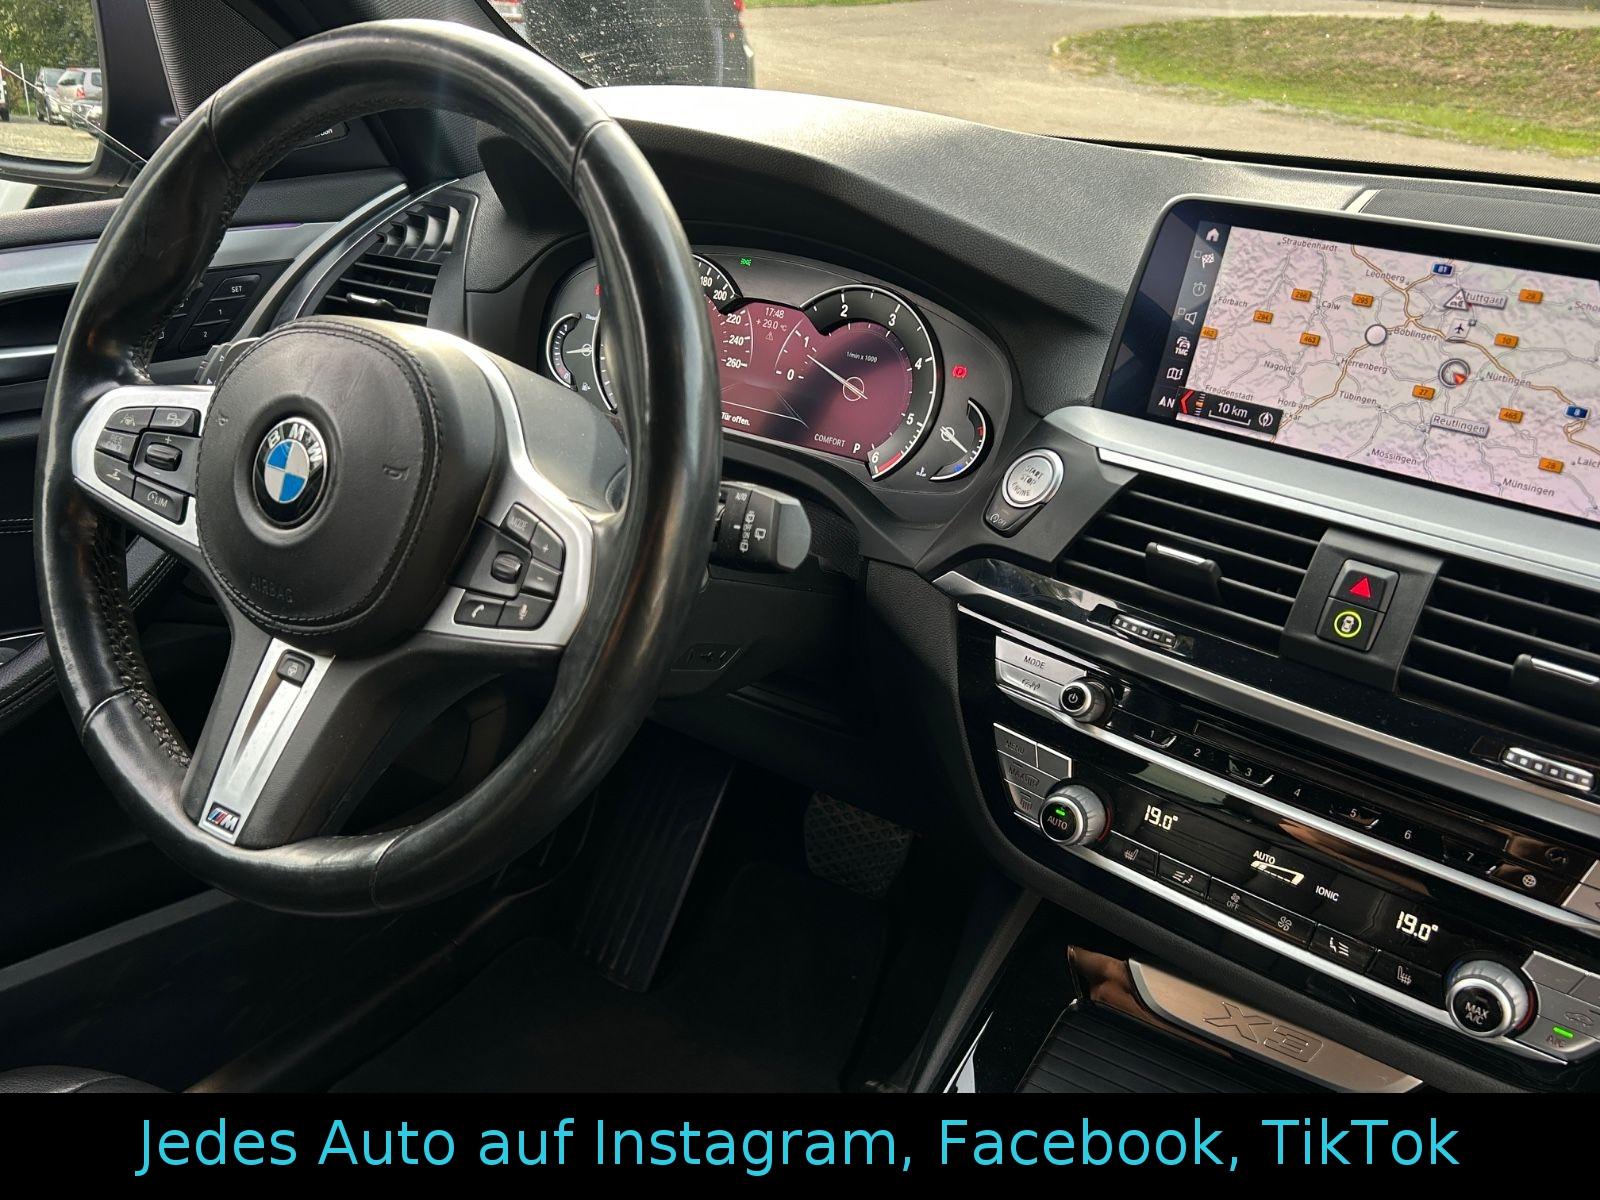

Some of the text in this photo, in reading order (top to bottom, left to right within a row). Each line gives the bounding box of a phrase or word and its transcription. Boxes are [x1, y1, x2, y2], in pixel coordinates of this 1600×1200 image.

[700, 275, 713, 287] 180
[1365, 269, 1406, 284] Leonberg
[713, 289, 727, 301] 200
[840, 304, 849, 317] 2
[1321, 300, 1341, 311] Calw
[726, 313, 742, 325] 220
[765, 307, 785, 318] 17:48
[888, 314, 897, 327] 3
[729, 335, 745, 347] 240
[803, 336, 810, 348] 1
[726, 357, 742, 369] 260
[864, 354, 878, 364] 1000
[914, 357, 922, 370] 4
[1263, 361, 1292, 373] Nagold
[1341, 357, 1388, 375] Herrenberg
[786, 369, 795, 381] 0
[1205, 384, 1254, 402] Freudenstadt
[1339, 391, 1377, 407] Tübingen
[1217, 402, 1248, 418] 10 km
[1277, 398, 1297, 409] Horb
[721, 411, 732, 421] Tür
[906, 413, 915, 425] 5
[1433, 415, 1486, 434] Reutlingen
[267, 422, 323, 468] BMW
[814, 432, 846, 448] COMFORT
[853, 443, 861, 454] P
[871, 450, 880, 464] 6
[1025, 464, 1044, 480] START
[1011, 481, 1032, 497] ENGINE
[1502, 477, 1556, 497] Münsingen
[153, 492, 169, 509] LIM
[250, 575, 294, 604] AIRBAG
[1023, 655, 1046, 671] MODE
[1193, 748, 1201, 758] 2
[1244, 768, 1253, 777] 3
[1293, 788, 1302, 798] 4
[1349, 808, 1358, 818] 5
[1047, 816, 1069, 831] AUTO
[1404, 830, 1412, 840] 6
[1253, 850, 1276, 866] AUTO
[1465, 852, 1475, 862] 7
[1315, 885, 1340, 903] IONIC
[1226, 900, 1240, 911] OFF
[1465, 1002, 1490, 1019] MAX
[1465, 1011, 1485, 1026] A/C
[1201, 1001, 1325, 1063] X3
